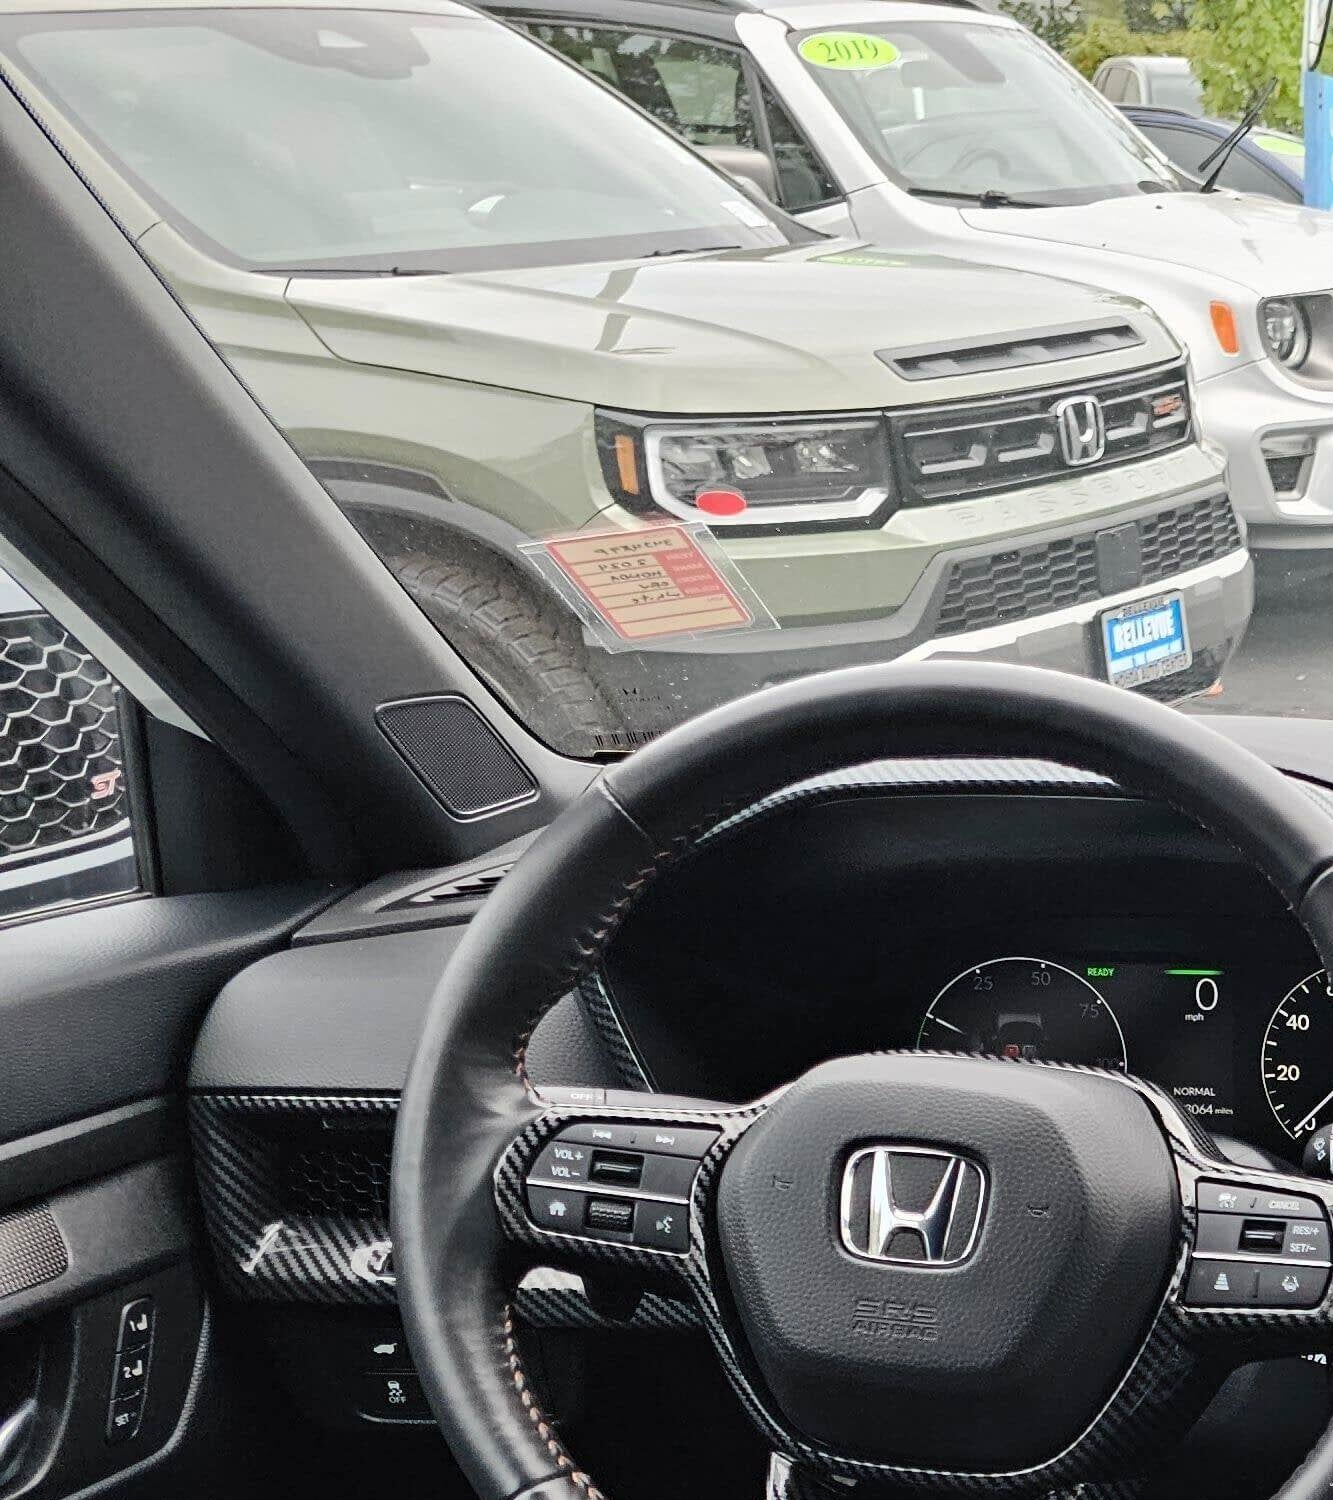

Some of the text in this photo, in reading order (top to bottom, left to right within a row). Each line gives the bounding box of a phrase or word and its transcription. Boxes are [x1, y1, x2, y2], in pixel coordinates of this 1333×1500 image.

[818, 39, 879, 62] 2019
[1111, 606, 1175, 654] BELLEVUE
[1031, 971, 1051, 986] 50
[1087, 967, 1115, 977] READY
[973, 976, 994, 991] 25
[1195, 978, 1219, 1011] 0
[1080, 1003, 1100, 1019] 75
[1185, 1013, 1204, 1023] mph
[1286, 1014, 1310, 1031] 40
[1276, 1065, 1300, 1081] 20
[1173, 1087, 1216, 1097] NORMAL
[1214, 1107, 1234, 1115] miles
[1267, 1200, 1300, 1211] CANCEL
[388, 1396, 407, 1404] OFF
